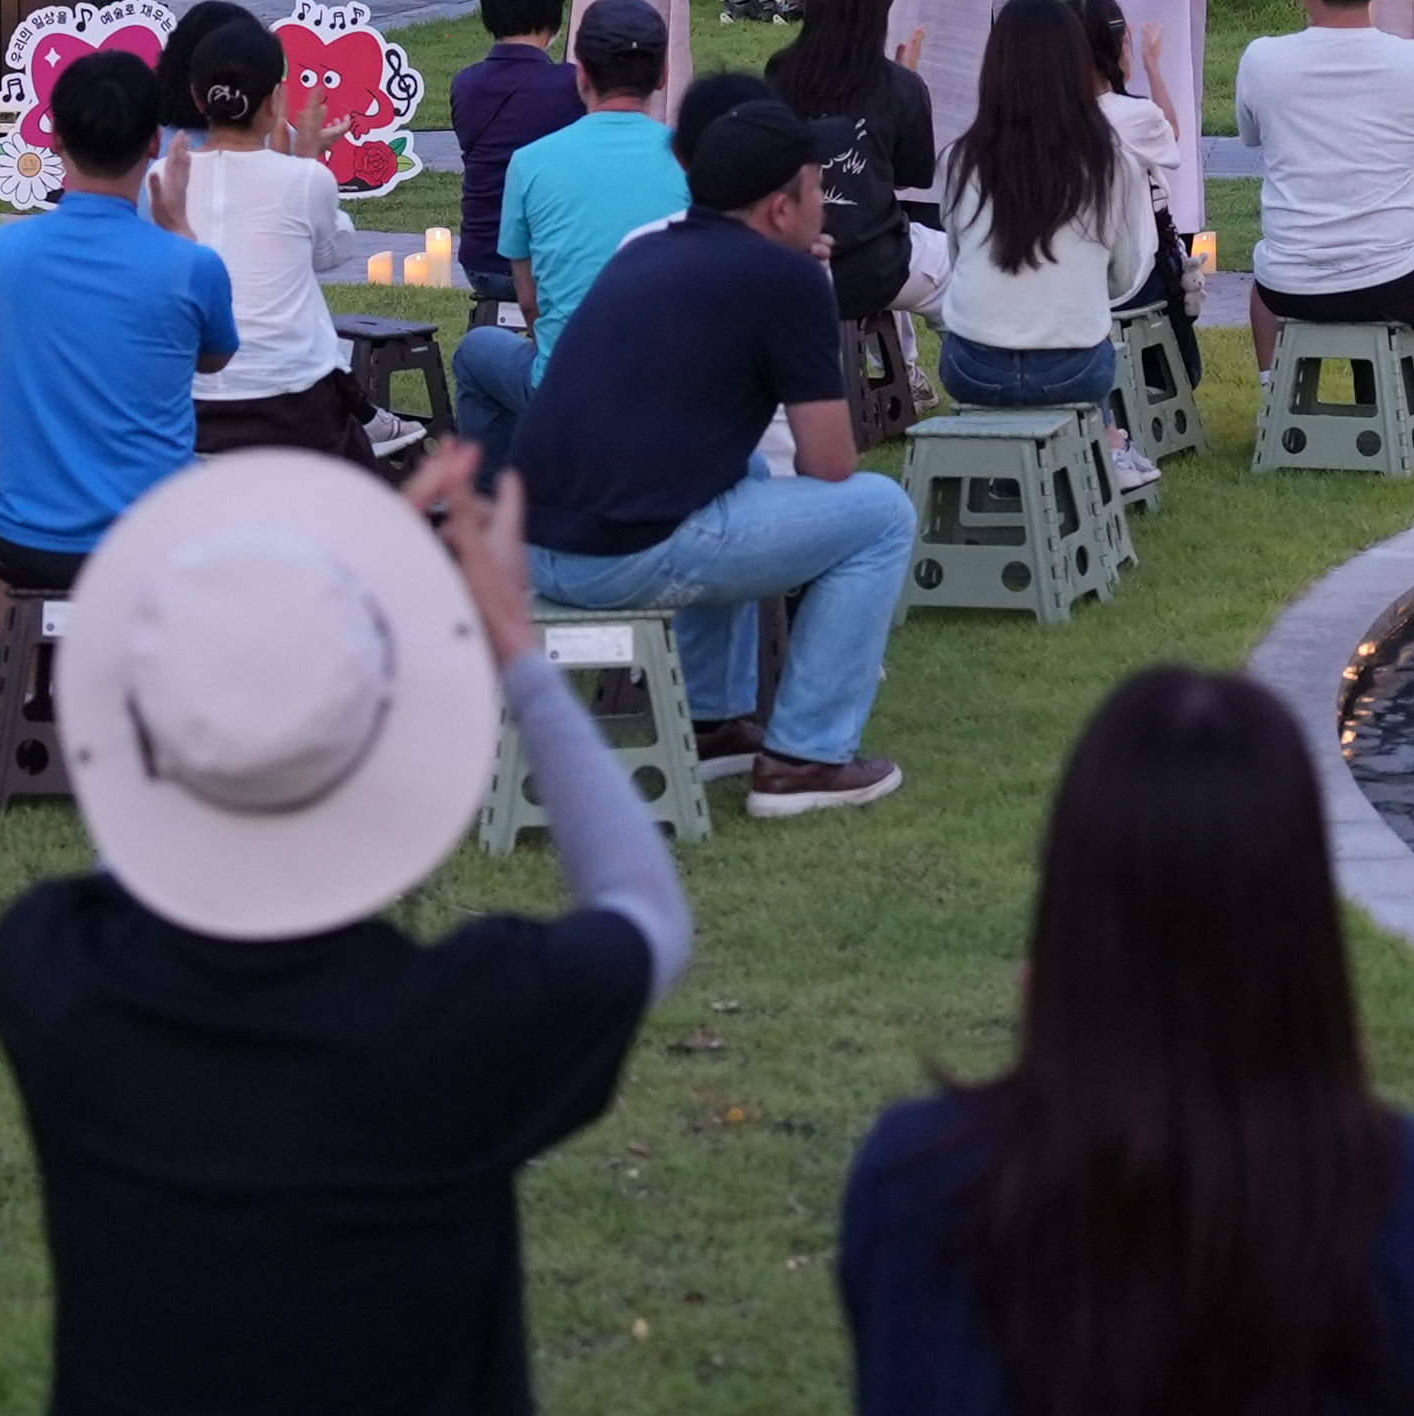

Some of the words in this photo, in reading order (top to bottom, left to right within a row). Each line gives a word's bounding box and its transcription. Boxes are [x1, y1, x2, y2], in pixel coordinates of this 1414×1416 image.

[11, 27, 34, 63] 우리의
[31, 10, 68, 30] 일상을
[100, 4, 136, 26] 예술로
[140, 3, 173, 32] 채우는
